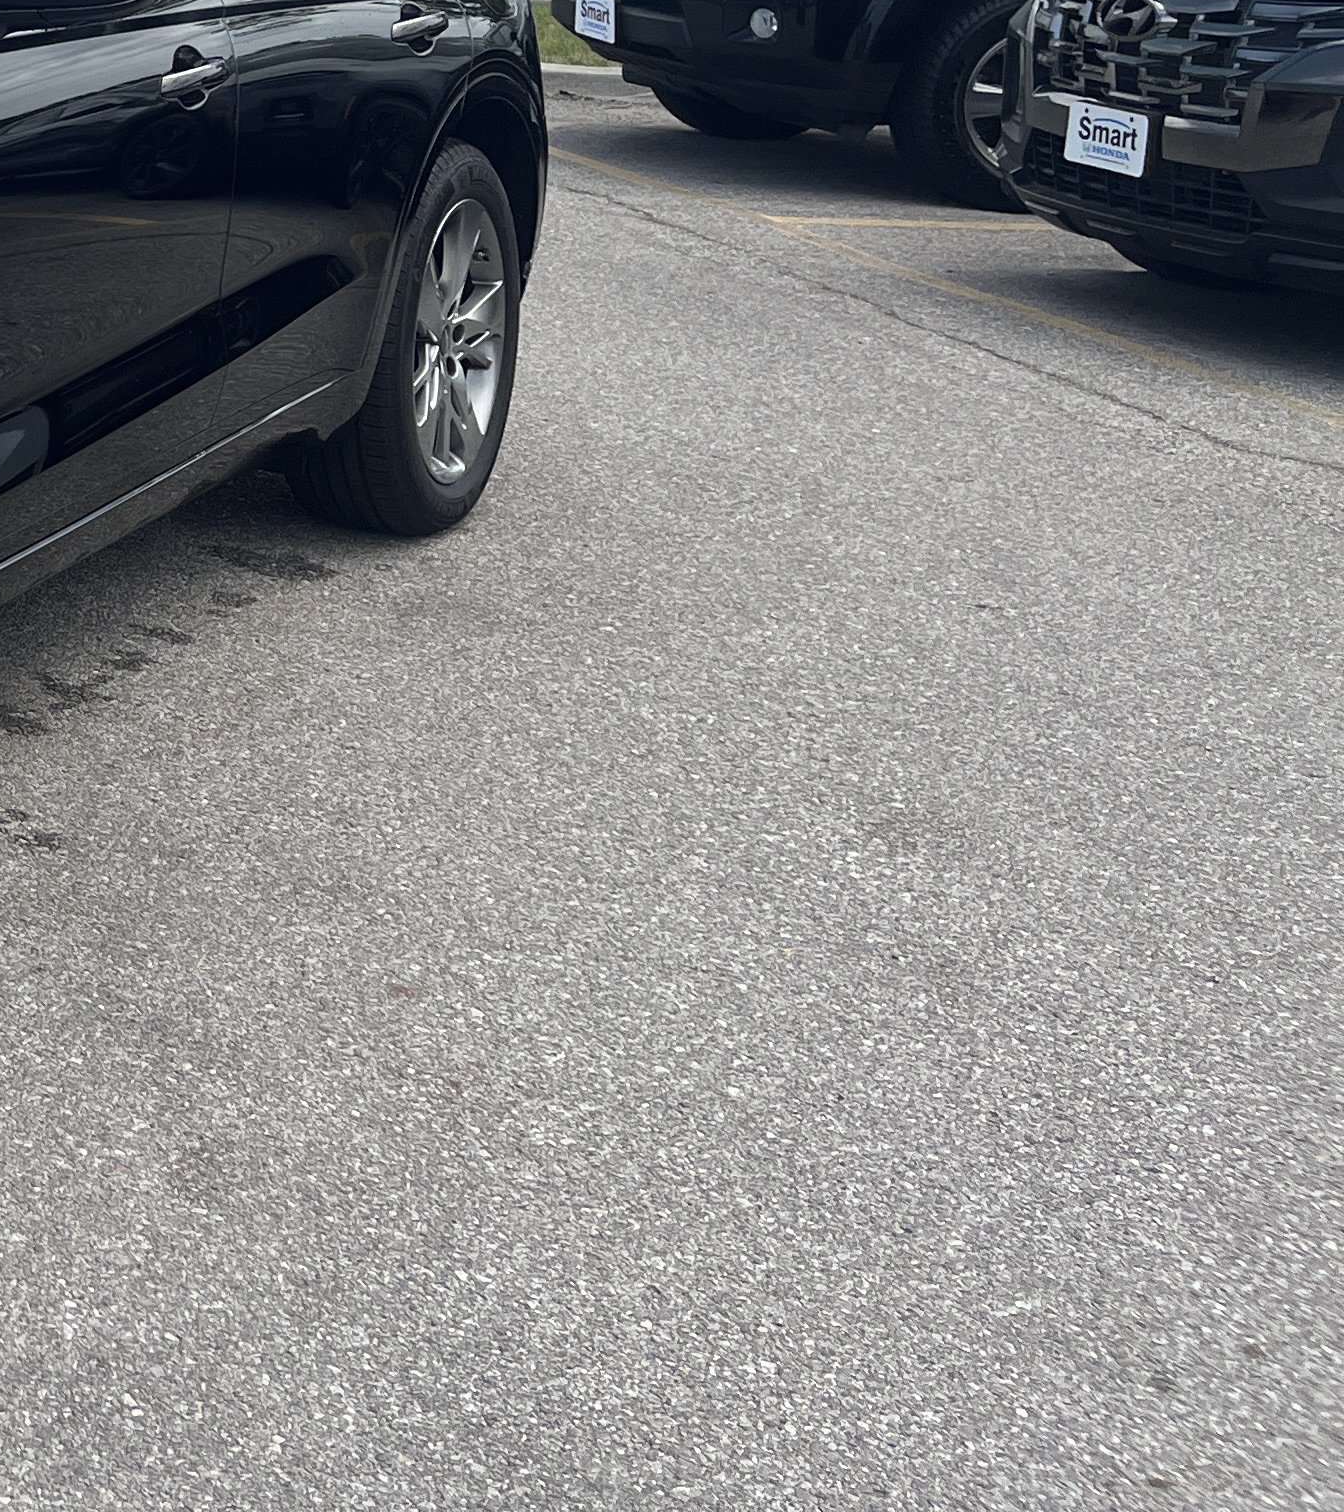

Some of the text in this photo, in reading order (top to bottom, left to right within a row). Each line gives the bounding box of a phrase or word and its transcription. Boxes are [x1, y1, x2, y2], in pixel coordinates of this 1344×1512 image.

[581, 0, 610, 25] Smart
[1078, 115, 1138, 151] Smart
[1092, 145, 1130, 161] HONDA
